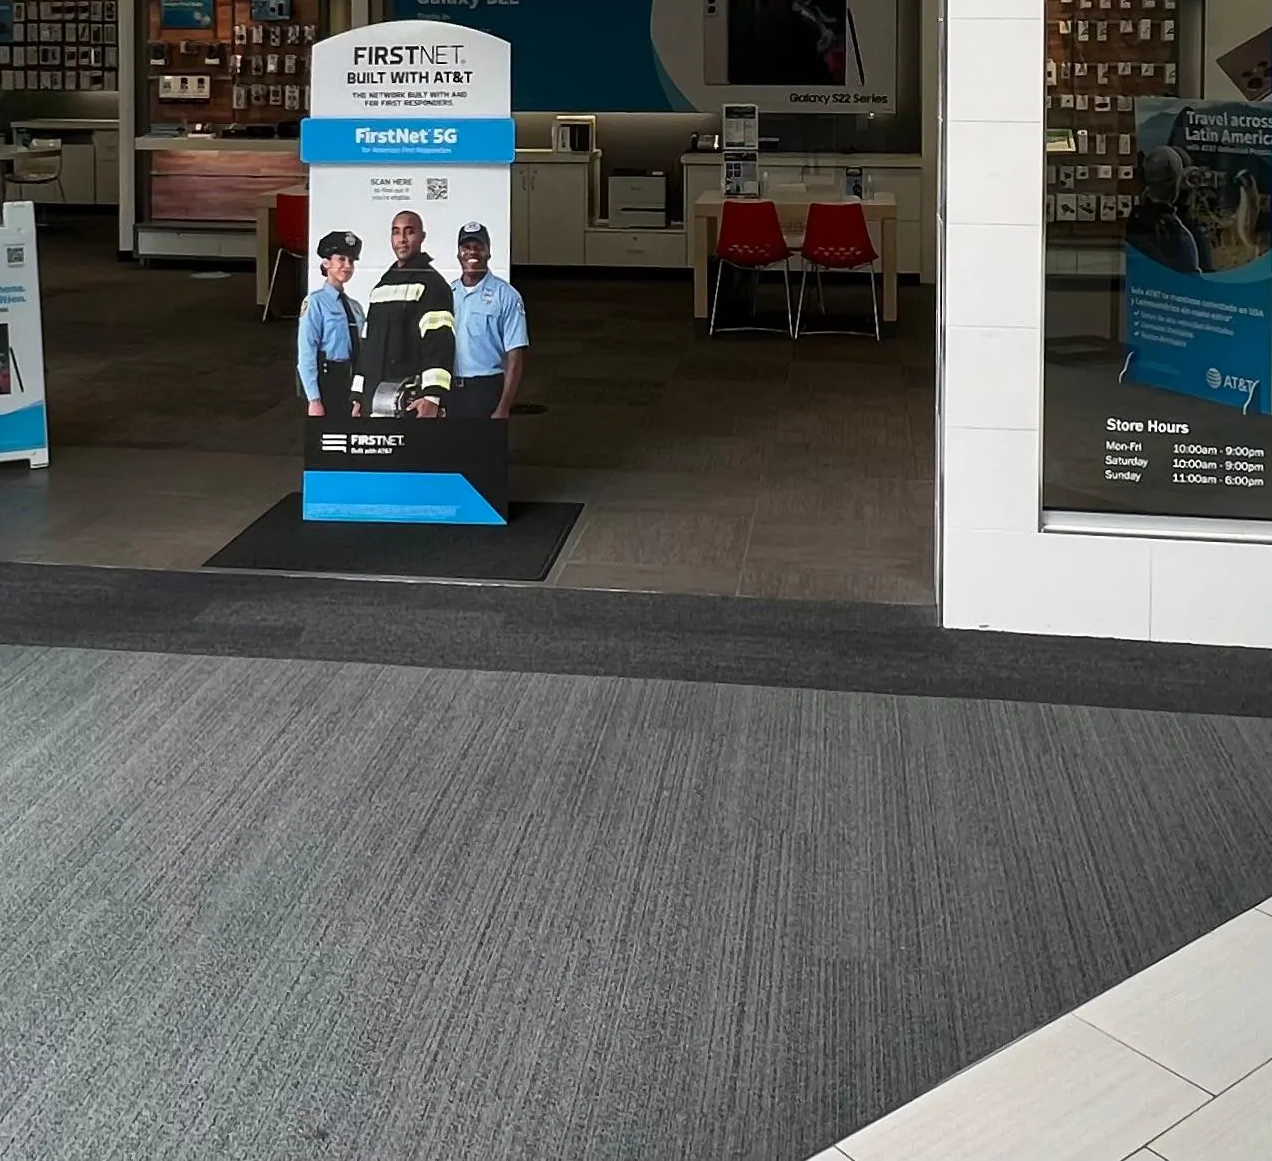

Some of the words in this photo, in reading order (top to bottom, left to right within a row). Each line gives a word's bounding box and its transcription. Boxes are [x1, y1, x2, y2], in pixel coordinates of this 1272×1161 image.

[353, 44, 466, 66] FIRSTNET
[347, 71, 387, 85] BUILT
[390, 71, 429, 84] WITH
[433, 70, 474, 84] AT&T
[352, 91, 367, 99] THE
[368, 91, 406, 99] NETWORK
[407, 91, 428, 99] BUILT
[429, 91, 450, 99] WITH
[364, 99, 379, 107] FOR
[380, 99, 402, 107] FIRST
[789, 93, 831, 105] Galaxy
[832, 93, 851, 104] S22
[853, 93, 888, 104] Series
[1186, 111, 1227, 127] Travel
[355, 127, 431, 145] FirstNet
[433, 127, 458, 144] 5G
[1185, 126, 1219, 143] Latin
[370, 178, 391, 186] SCAN
[392, 178, 412, 186] HERE
[1223, 375, 1258, 393] AT&T
[1106, 417, 1145, 433] Store
[1147, 419, 1190, 434] Hours
[350, 434, 405, 446] FIRSTNET
[1105, 440, 1143, 452] Mon-Fri
[1172, 443, 1218, 456] 10:00am
[1225, 446, 1265, 458] 9:00pm
[1105, 455, 1149, 468] Saturday
[1172, 459, 1217, 470] 10:00am
[1225, 461, 1265, 473] 9:00pm
[1104, 469, 1143, 483] Sunday
[1172, 473, 1217, 485] 11:00am
[1224, 475, 1265, 488] 6:00pm
